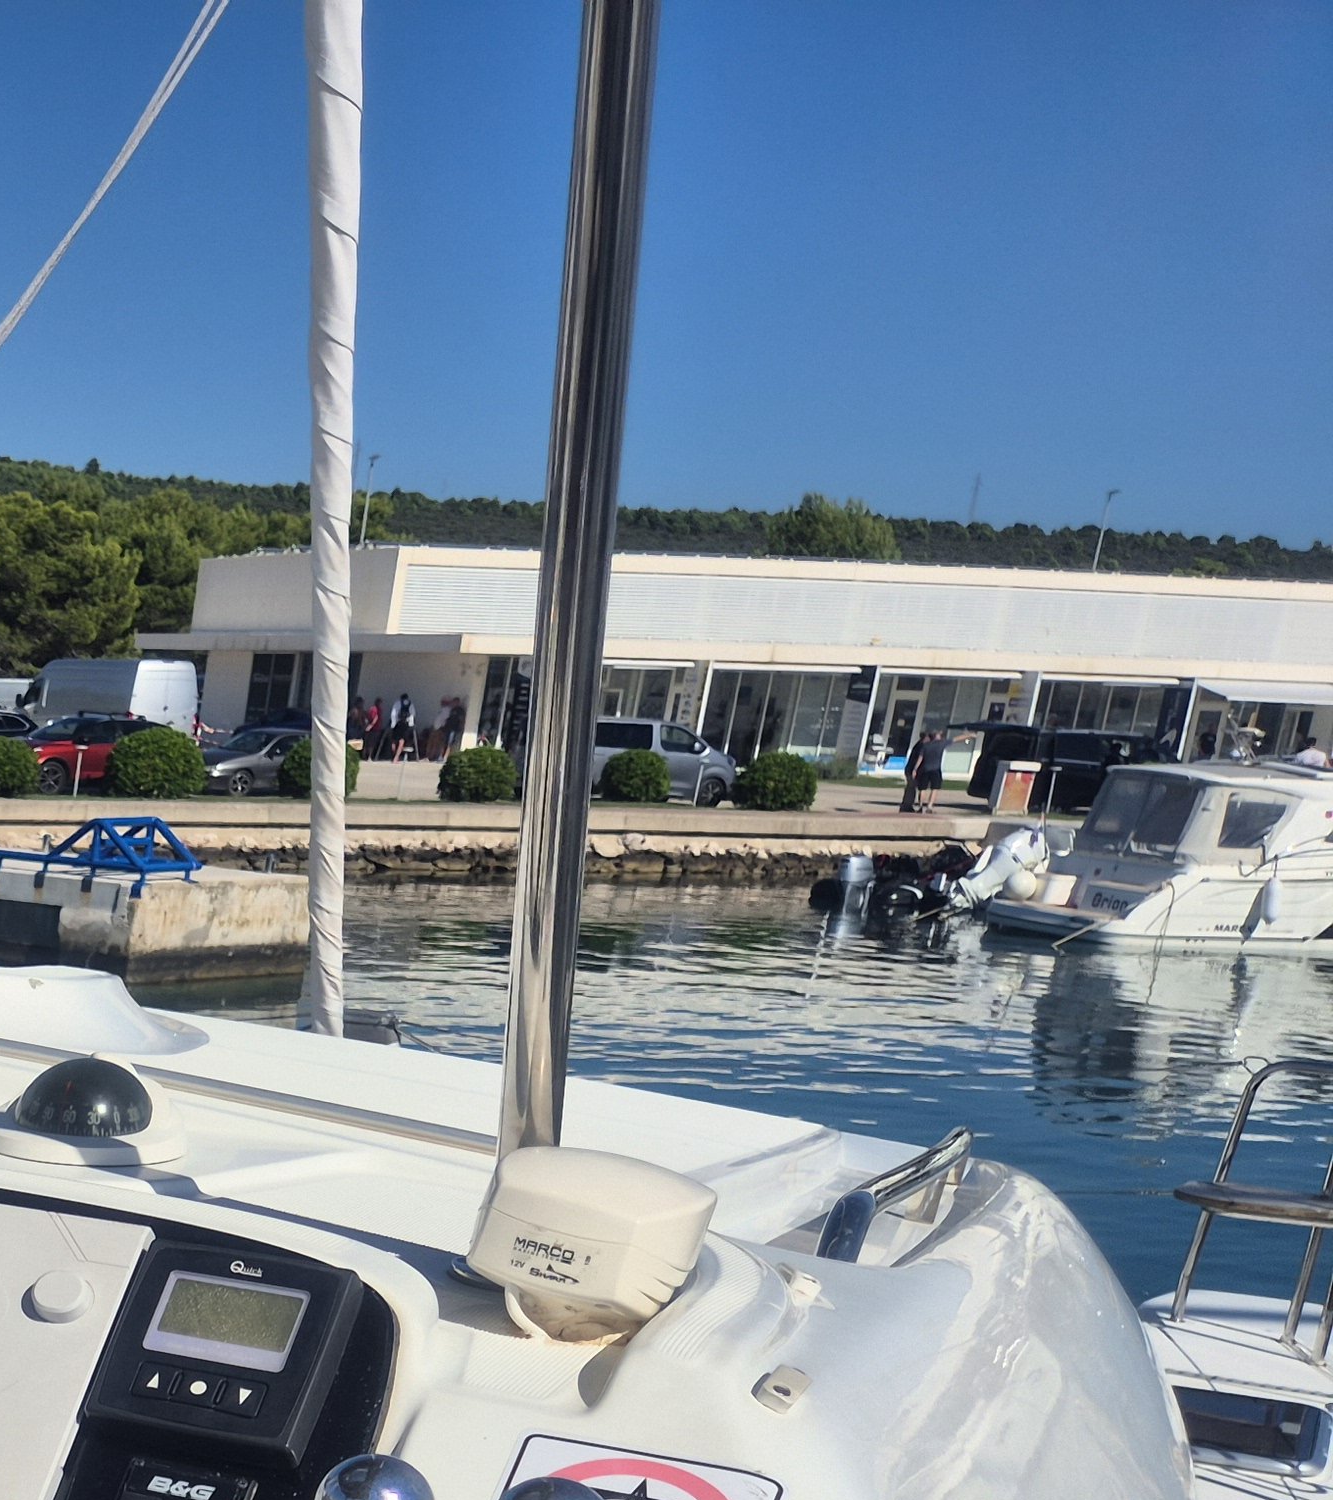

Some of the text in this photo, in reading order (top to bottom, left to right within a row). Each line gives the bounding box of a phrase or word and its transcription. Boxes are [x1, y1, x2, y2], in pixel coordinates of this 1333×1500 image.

[1091, 893, 1128, 911] Orion
[63, 1110, 76, 1123] 60
[87, 1111, 101, 1125] 30
[114, 1111, 120, 1124] 0
[514, 1237, 575, 1260] MARCO
[230, 1260, 263, 1277] Quick
